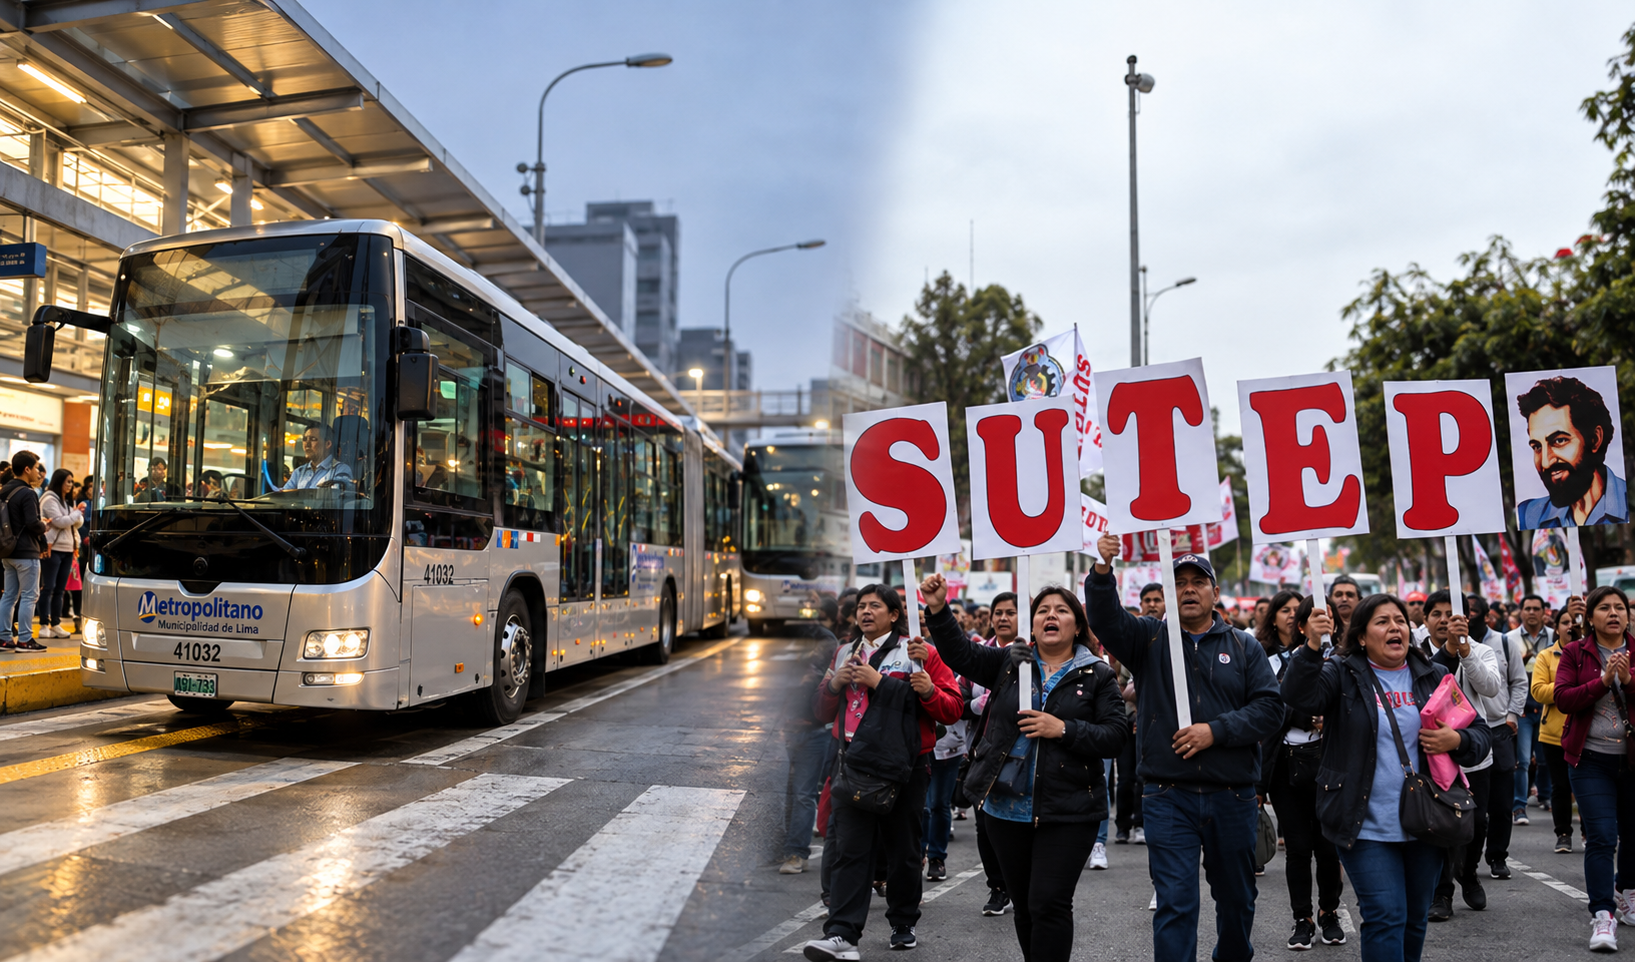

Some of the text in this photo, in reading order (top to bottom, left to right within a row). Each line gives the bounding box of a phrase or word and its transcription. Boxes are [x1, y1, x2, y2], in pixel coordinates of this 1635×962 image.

[424, 563, 455, 585] 41032
[138, 591, 264, 624] Metropolitano
[157, 620, 259, 635] Municipalidad de Lima
[173, 641, 221, 662] 41032
